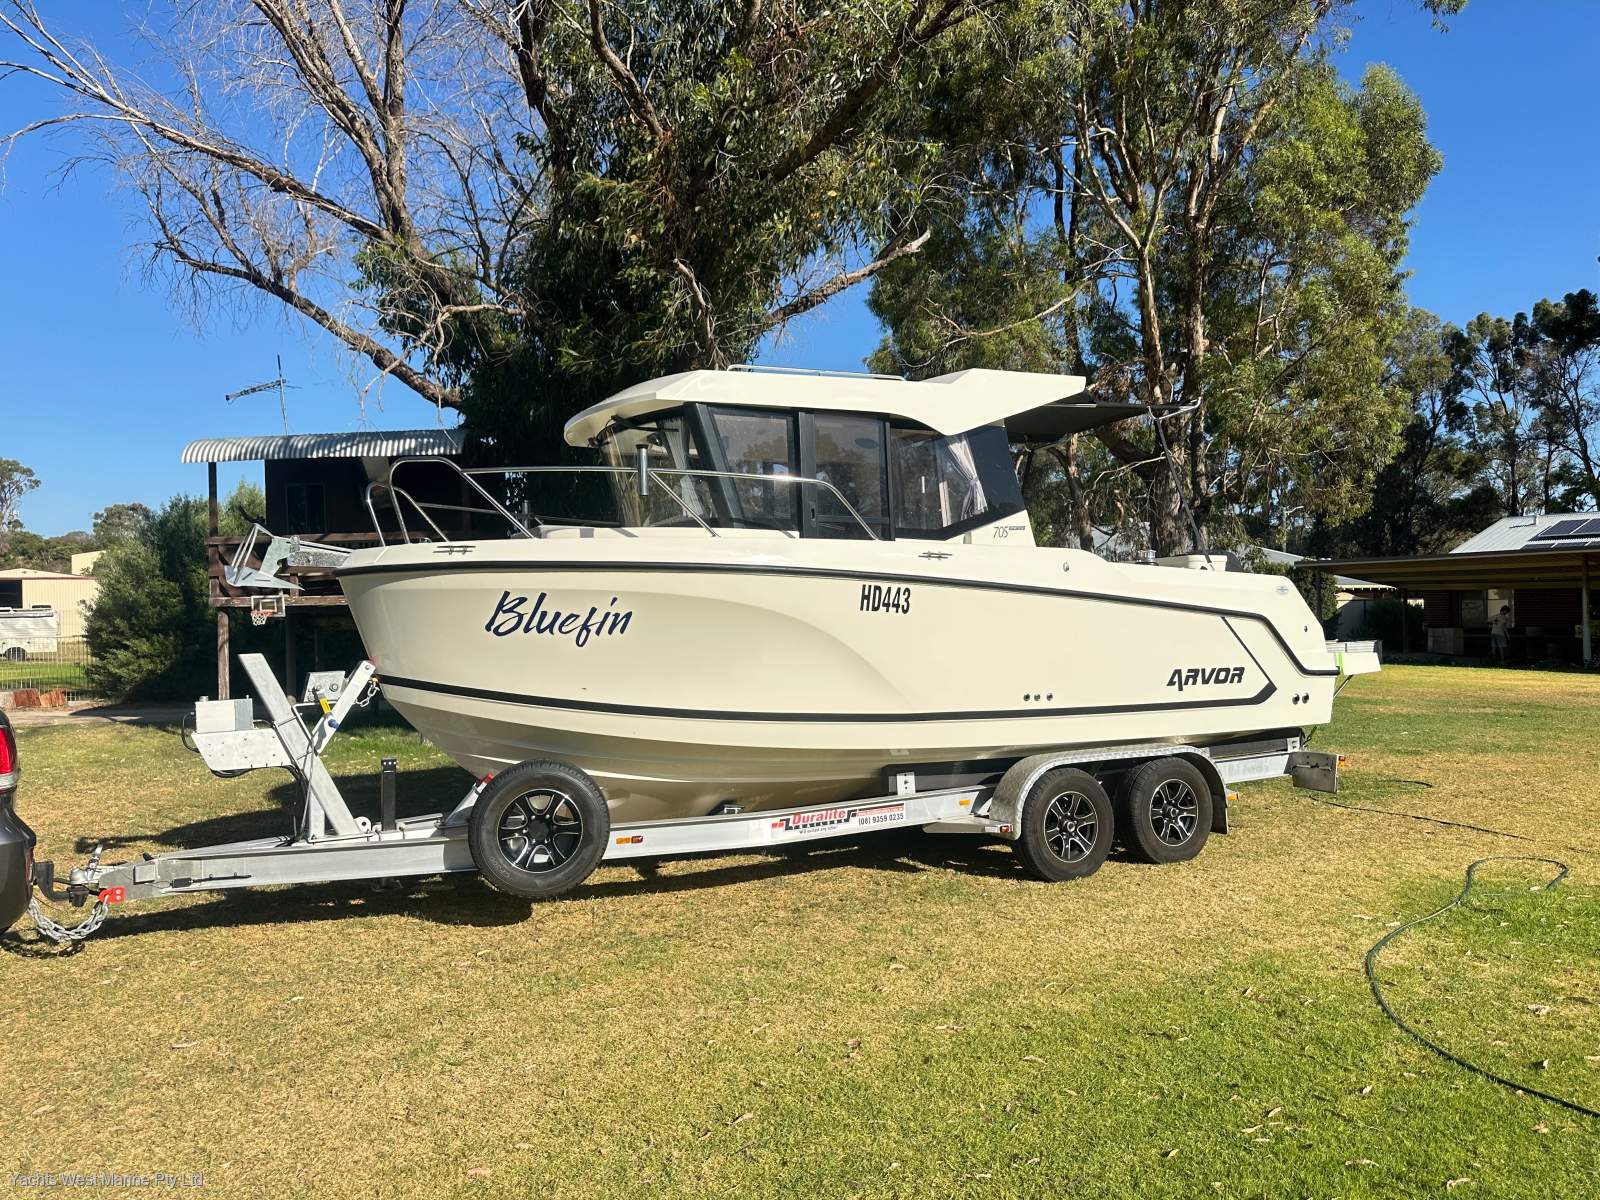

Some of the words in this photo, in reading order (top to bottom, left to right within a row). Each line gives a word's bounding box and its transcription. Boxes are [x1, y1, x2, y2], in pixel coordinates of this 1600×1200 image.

[993, 525, 1009, 538] 705
[860, 584, 911, 614] HD443
[485, 590, 633, 648] Bluefin
[1166, 666, 1246, 692] ARVOR
[792, 808, 846, 825] Duralite
[858, 817, 871, 826] (08)
[872, 814, 888, 824] 9359
[889, 812, 904, 821] 0235
